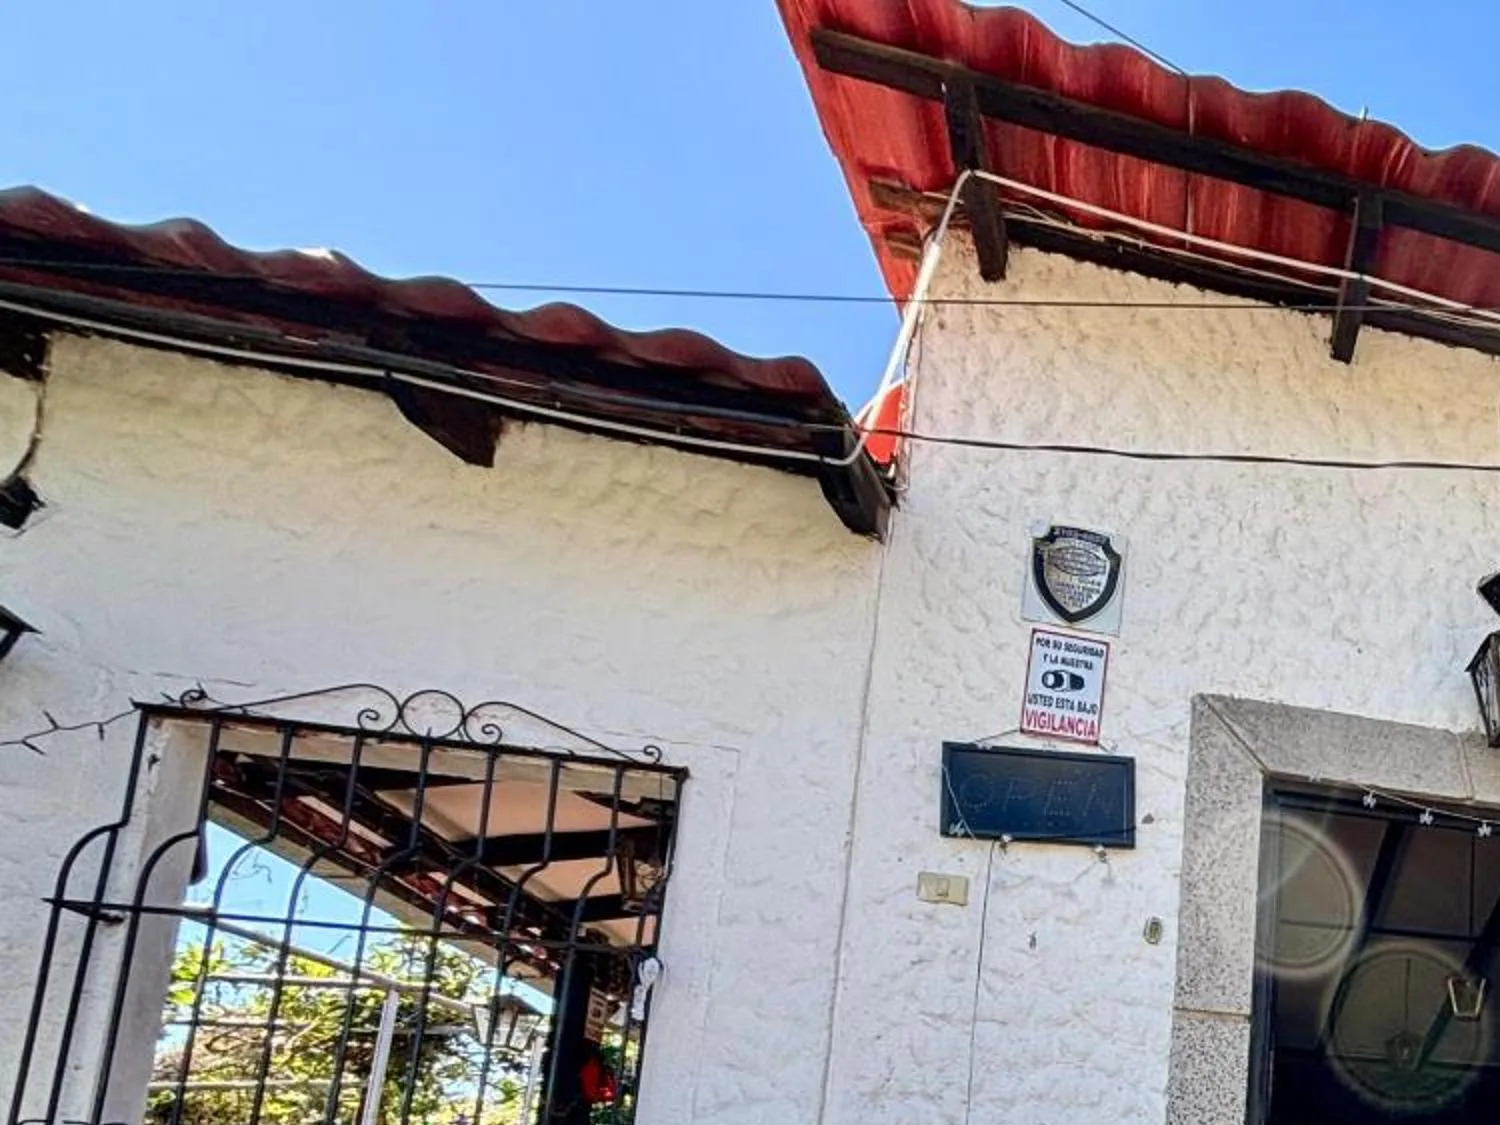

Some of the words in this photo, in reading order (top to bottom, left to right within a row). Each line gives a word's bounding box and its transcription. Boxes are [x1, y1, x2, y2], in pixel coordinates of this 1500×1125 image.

[1052, 639, 1062, 651] SU
[1063, 641, 1105, 659] SEGURIDAD
[1049, 654, 1059, 665] LA
[1060, 656, 1094, 671] NUESTRA
[1027, 693, 1054, 708] USTED
[1055, 697, 1075, 711] ESTA
[1077, 701, 1098, 715] BAJO
[1025, 709, 1097, 737] VIGILANCIA
